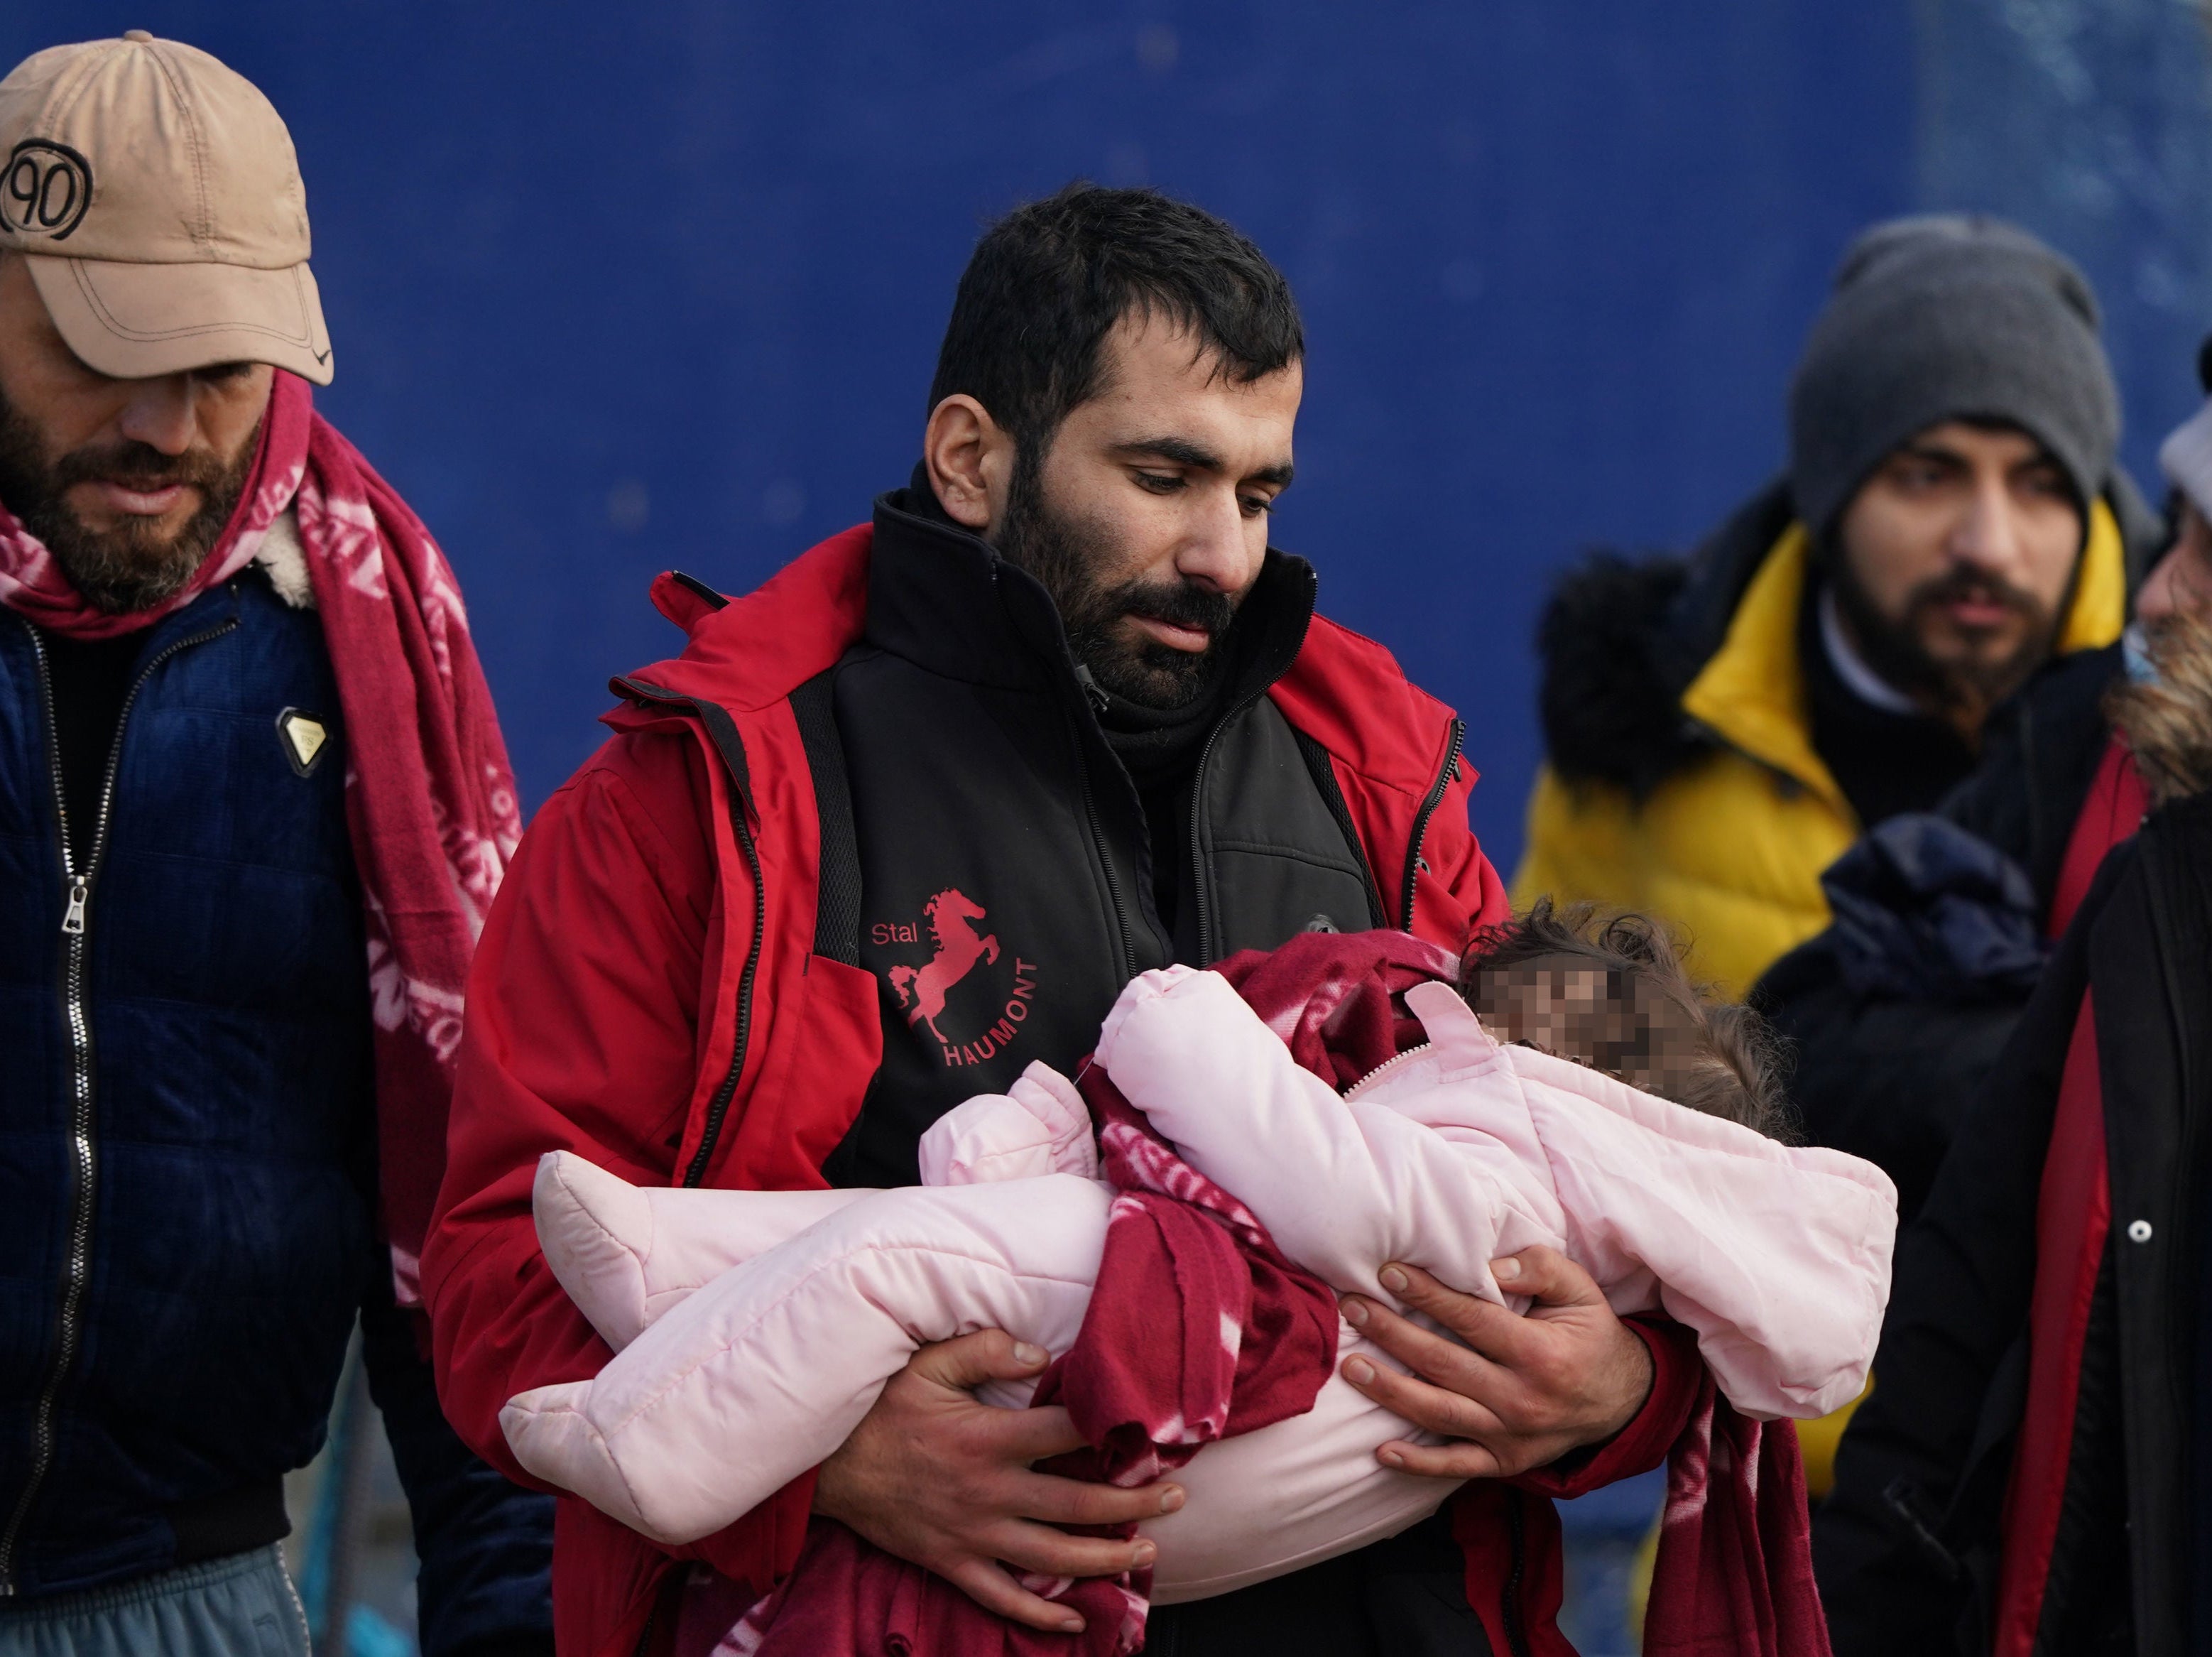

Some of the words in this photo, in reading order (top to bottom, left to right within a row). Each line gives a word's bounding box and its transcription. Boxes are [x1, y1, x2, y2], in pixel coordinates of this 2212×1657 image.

[11, 156, 76, 227] 90
[872, 923, 917, 945] Stal
[943, 957, 1037, 1067] HAUMONT
